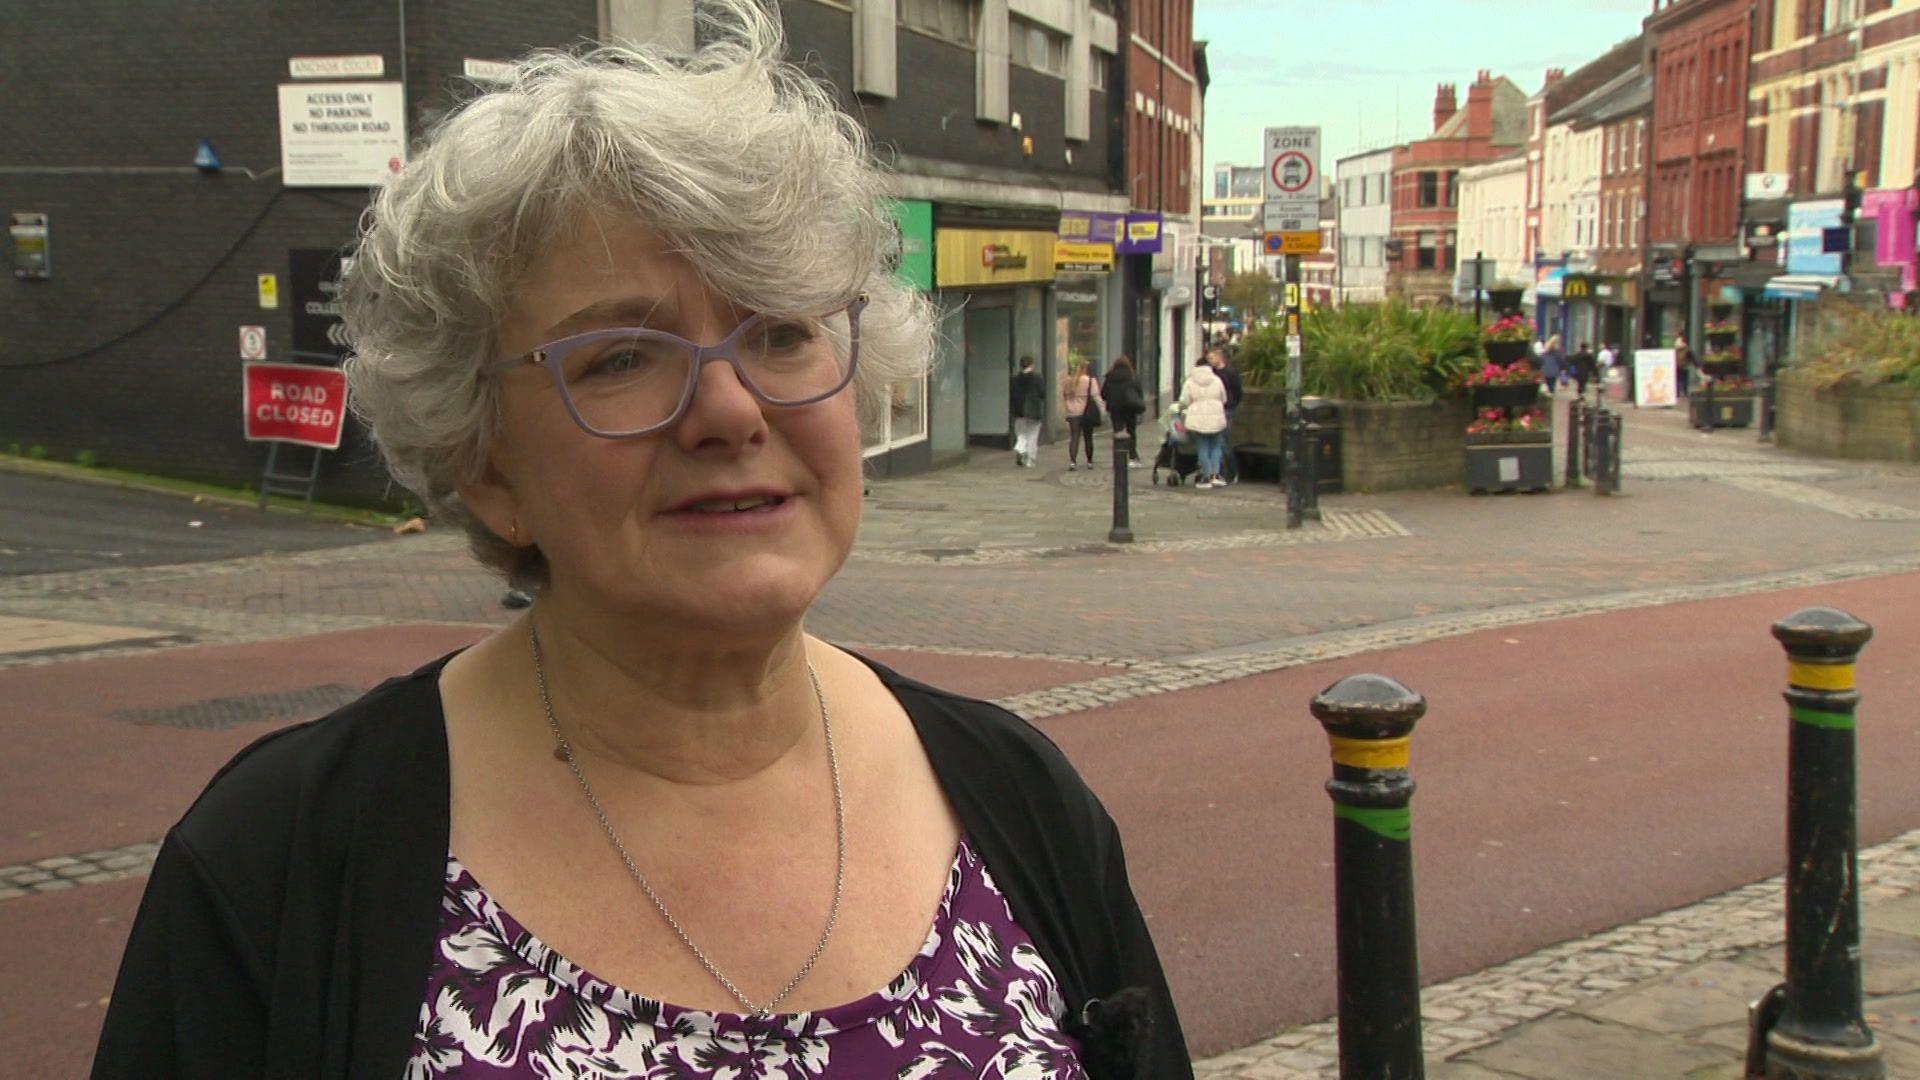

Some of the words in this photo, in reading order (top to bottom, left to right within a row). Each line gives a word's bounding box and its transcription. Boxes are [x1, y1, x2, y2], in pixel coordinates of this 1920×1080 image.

[306, 93, 344, 104] ACCESS
[345, 92, 373, 104] ONLY
[309, 108, 325, 118] NO
[326, 107, 373, 118] PARKING
[292, 122, 308, 133] NO
[310, 121, 359, 133] THROUGH
[361, 121, 392, 133] ROAD
[1273, 136, 1313, 149] ZONE
[270, 382, 328, 405] ROAD
[256, 403, 335, 428] CLOSED
